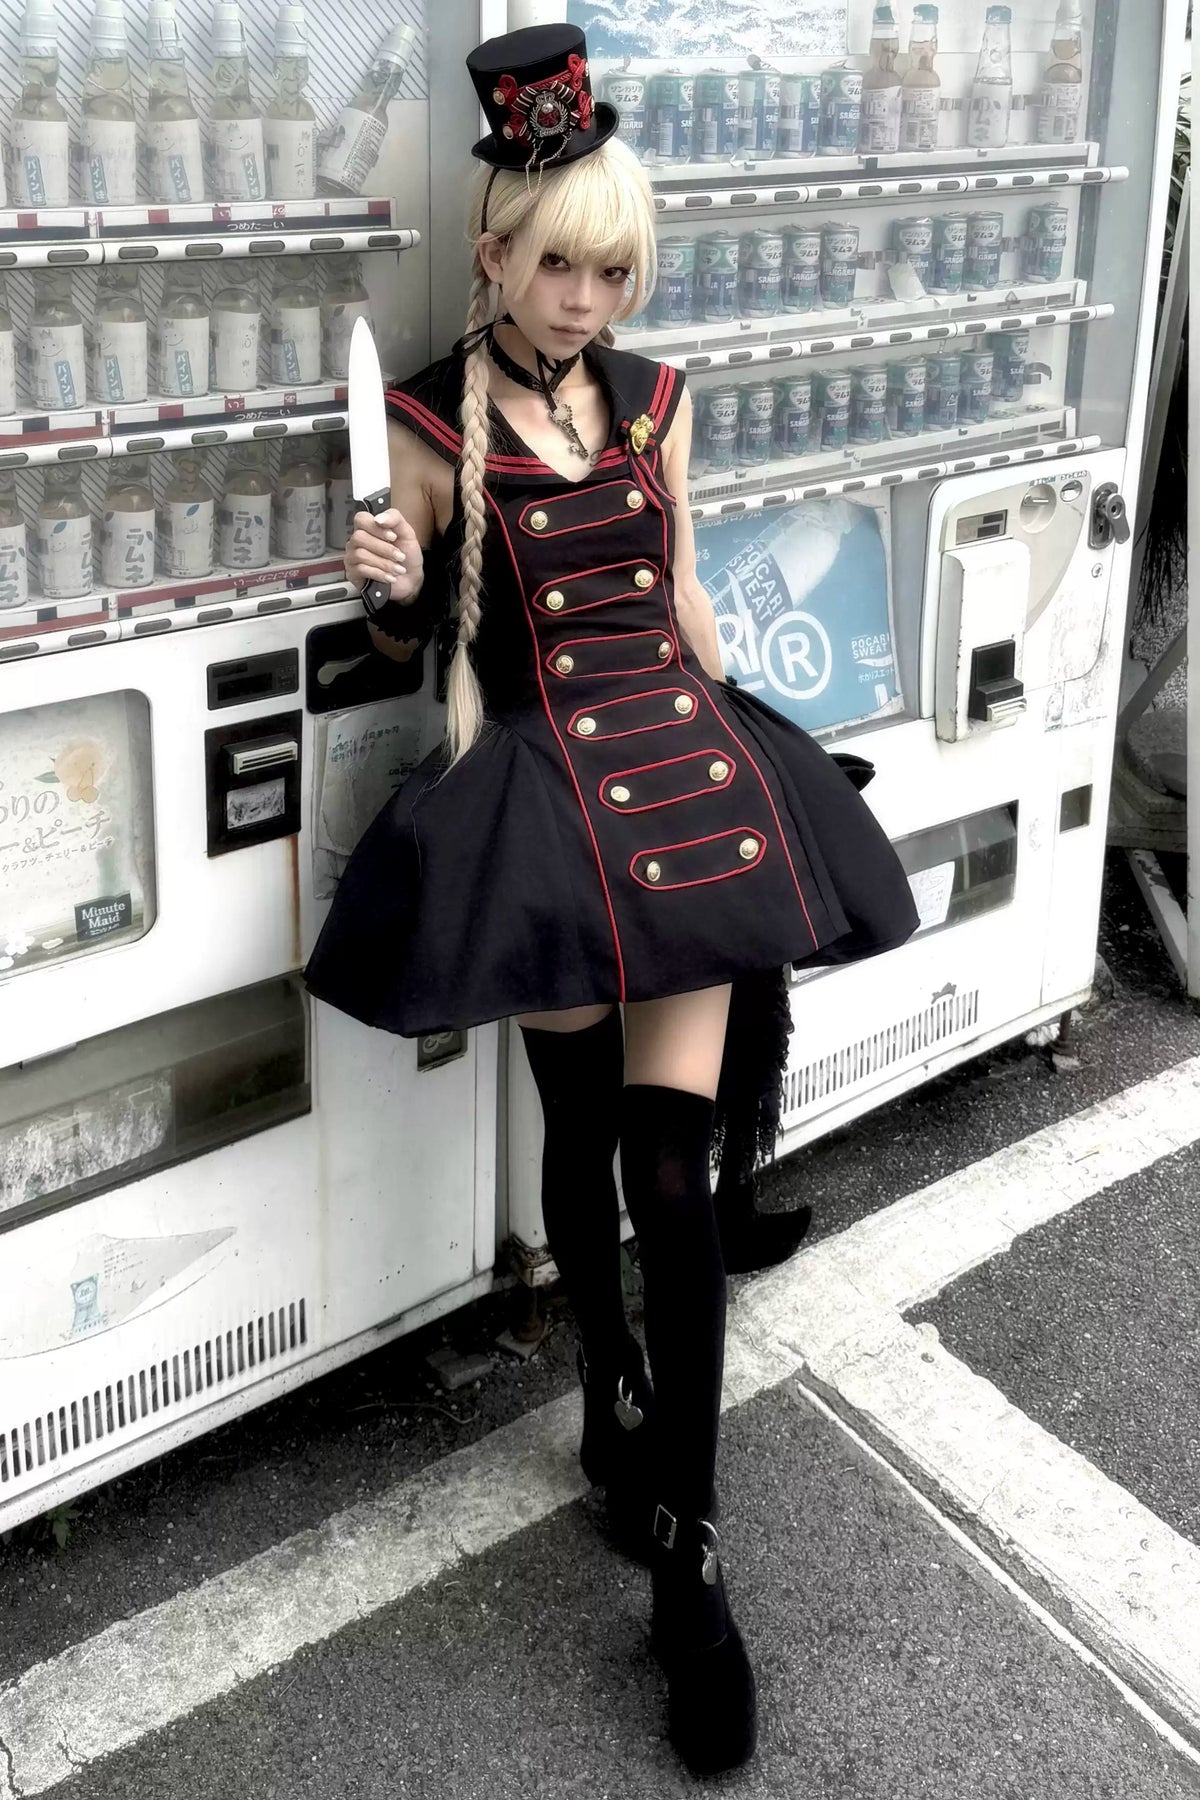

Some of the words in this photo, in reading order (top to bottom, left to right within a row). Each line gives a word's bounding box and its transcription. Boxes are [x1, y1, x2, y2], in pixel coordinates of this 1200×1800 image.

[615, 94, 640, 103] ラムネ
[233, 510, 253, 563] ラムネ
[305, 501, 321, 553] ラムネ
[124, 528, 145, 583] ラムネ
[729, 554, 773, 621] SWEAT
[745, 545, 786, 618] POCARI
[851, 632, 890, 650] POCARI
[853, 643, 888, 659] SWEAT
[81, 901, 126, 921] Minute
[88, 911, 121, 930] Maid
